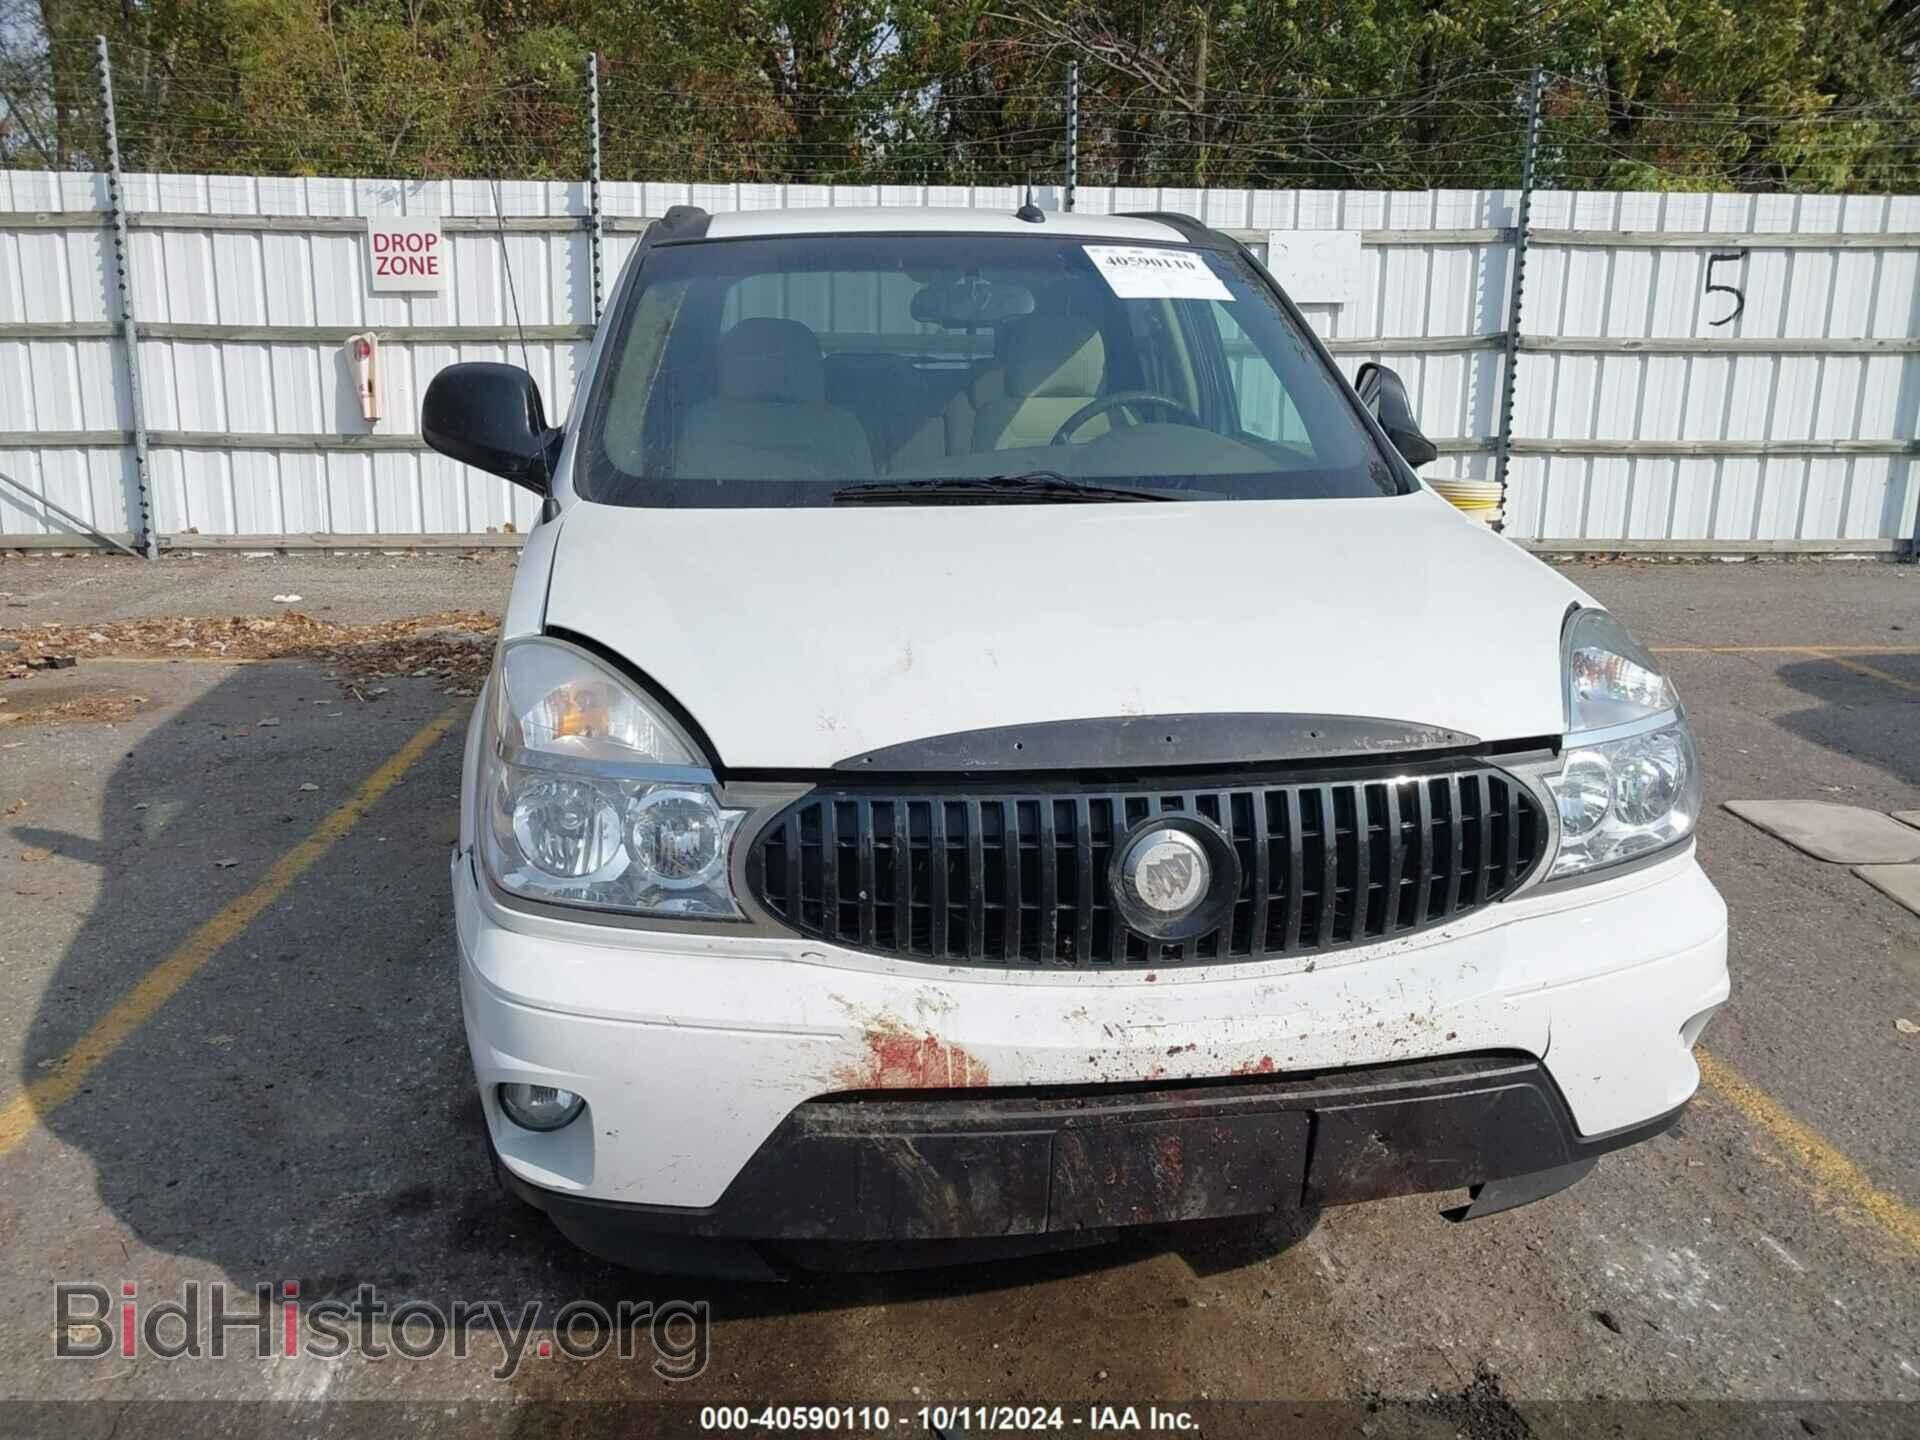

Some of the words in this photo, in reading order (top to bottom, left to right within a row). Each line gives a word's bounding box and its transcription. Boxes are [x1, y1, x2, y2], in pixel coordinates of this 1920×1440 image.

[373, 233, 438, 253] DROP
[376, 256, 439, 276] ZONE
[1105, 256, 1196, 271] 40590110
[1705, 249, 1747, 326] 5
